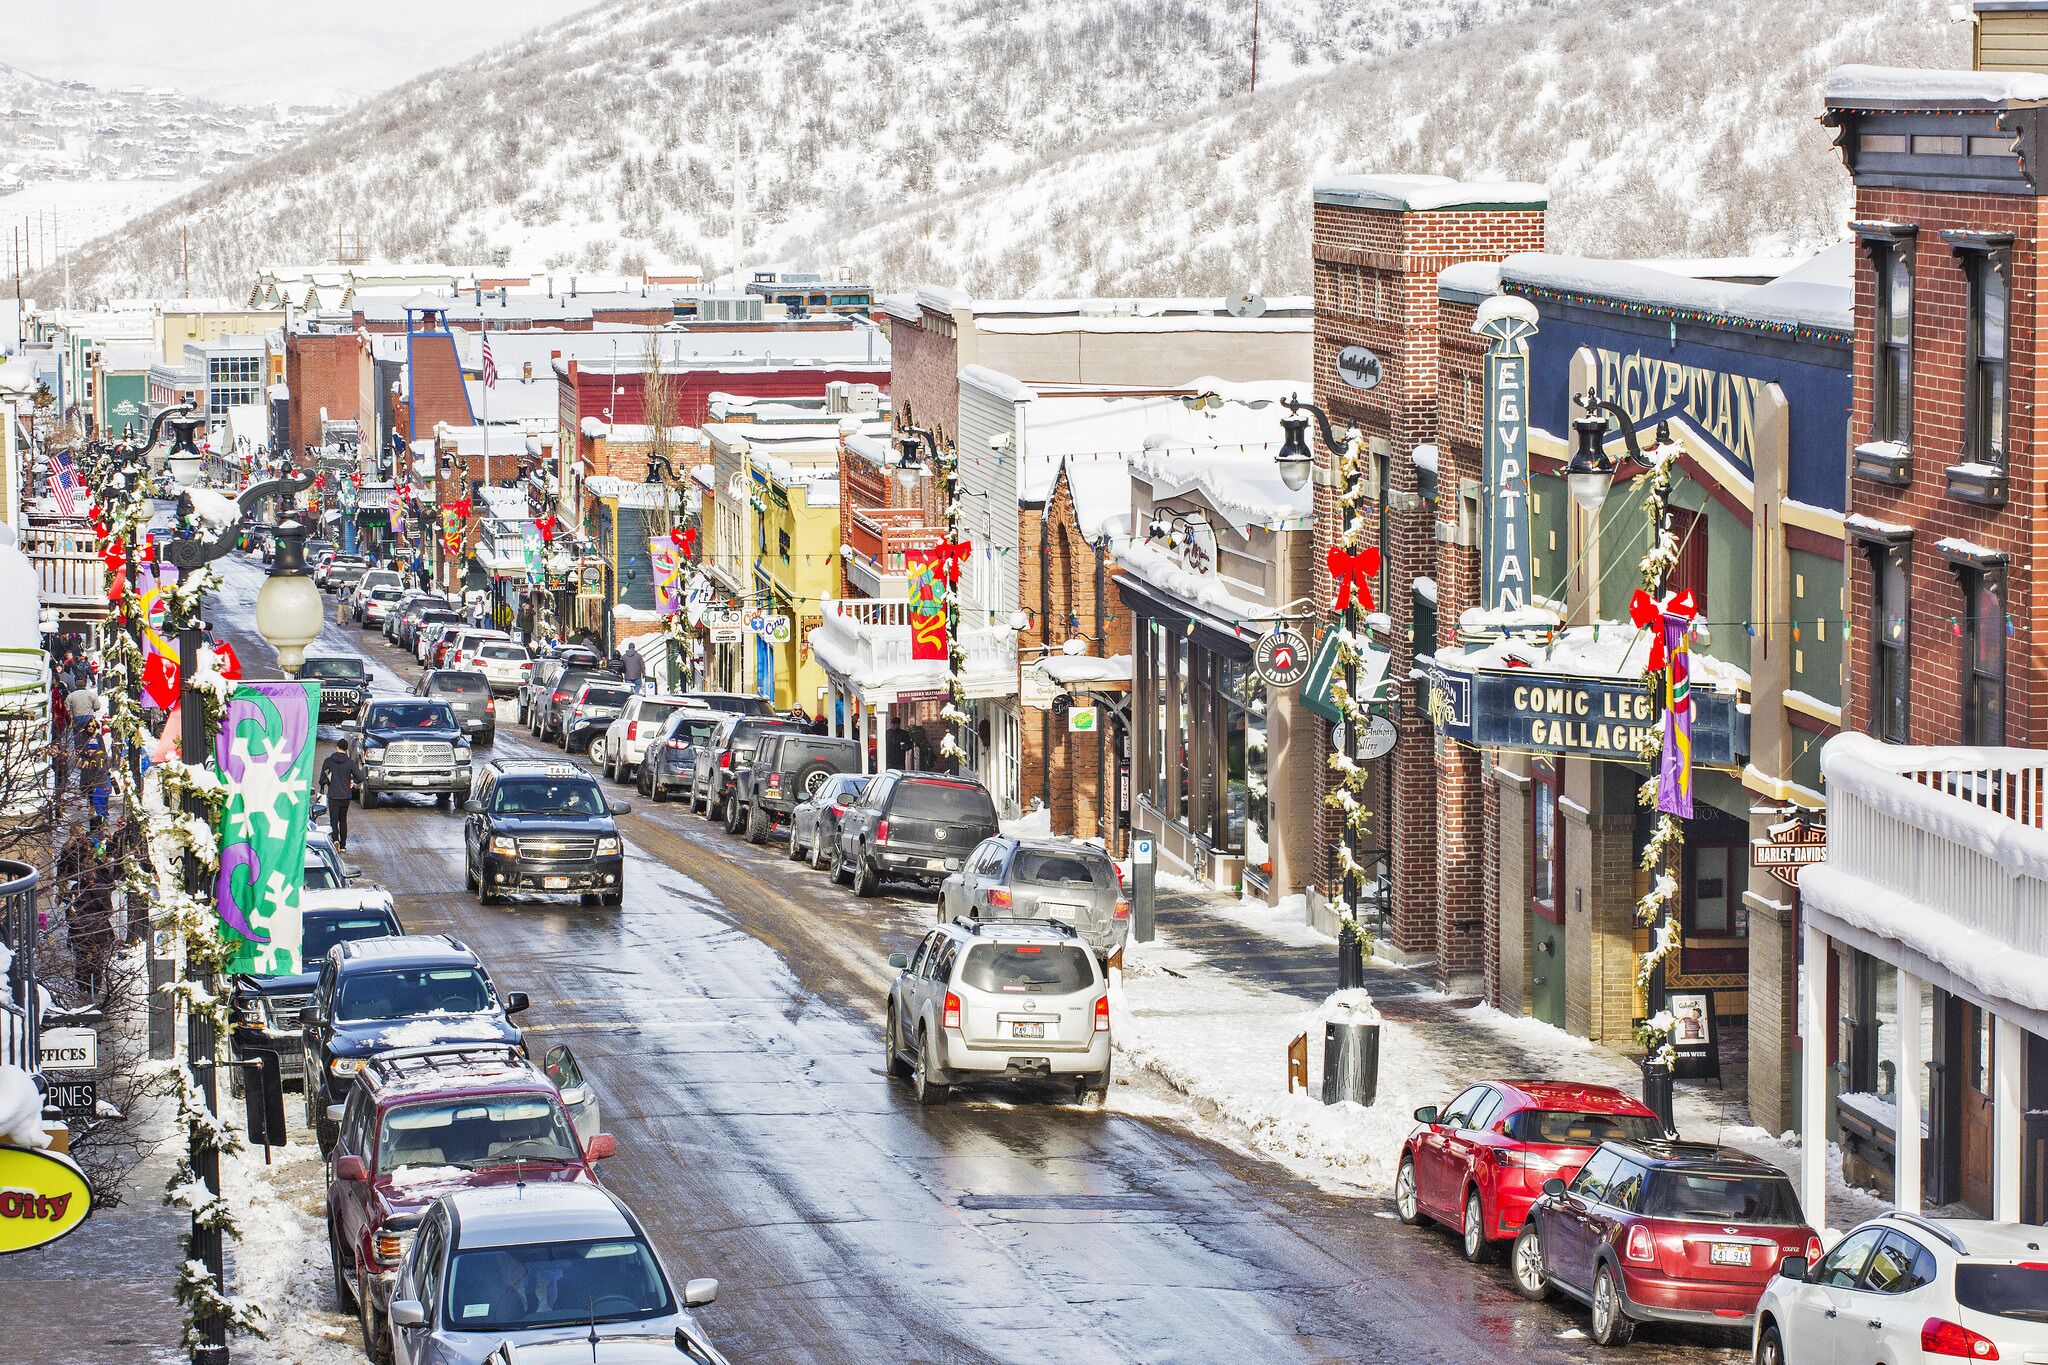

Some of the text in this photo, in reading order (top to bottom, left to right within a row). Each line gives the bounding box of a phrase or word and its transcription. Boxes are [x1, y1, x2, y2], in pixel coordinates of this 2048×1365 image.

[1597, 347, 1766, 470] EGYPTIAN
[1498, 362, 1525, 614] EGYPTIAN
[1259, 633, 1307, 662] OUTFITTER TRADING
[1265, 667, 1301, 682] COMPANY
[1513, 686, 1589, 716] COMIC
[1531, 719, 1651, 751] GALLAGH
[1757, 846, 1826, 863] HARLEY-DAVIDS
[40, 1047, 87, 1062] FFICES
[48, 1085, 93, 1107] PINES
[0, 1191, 72, 1222] City
